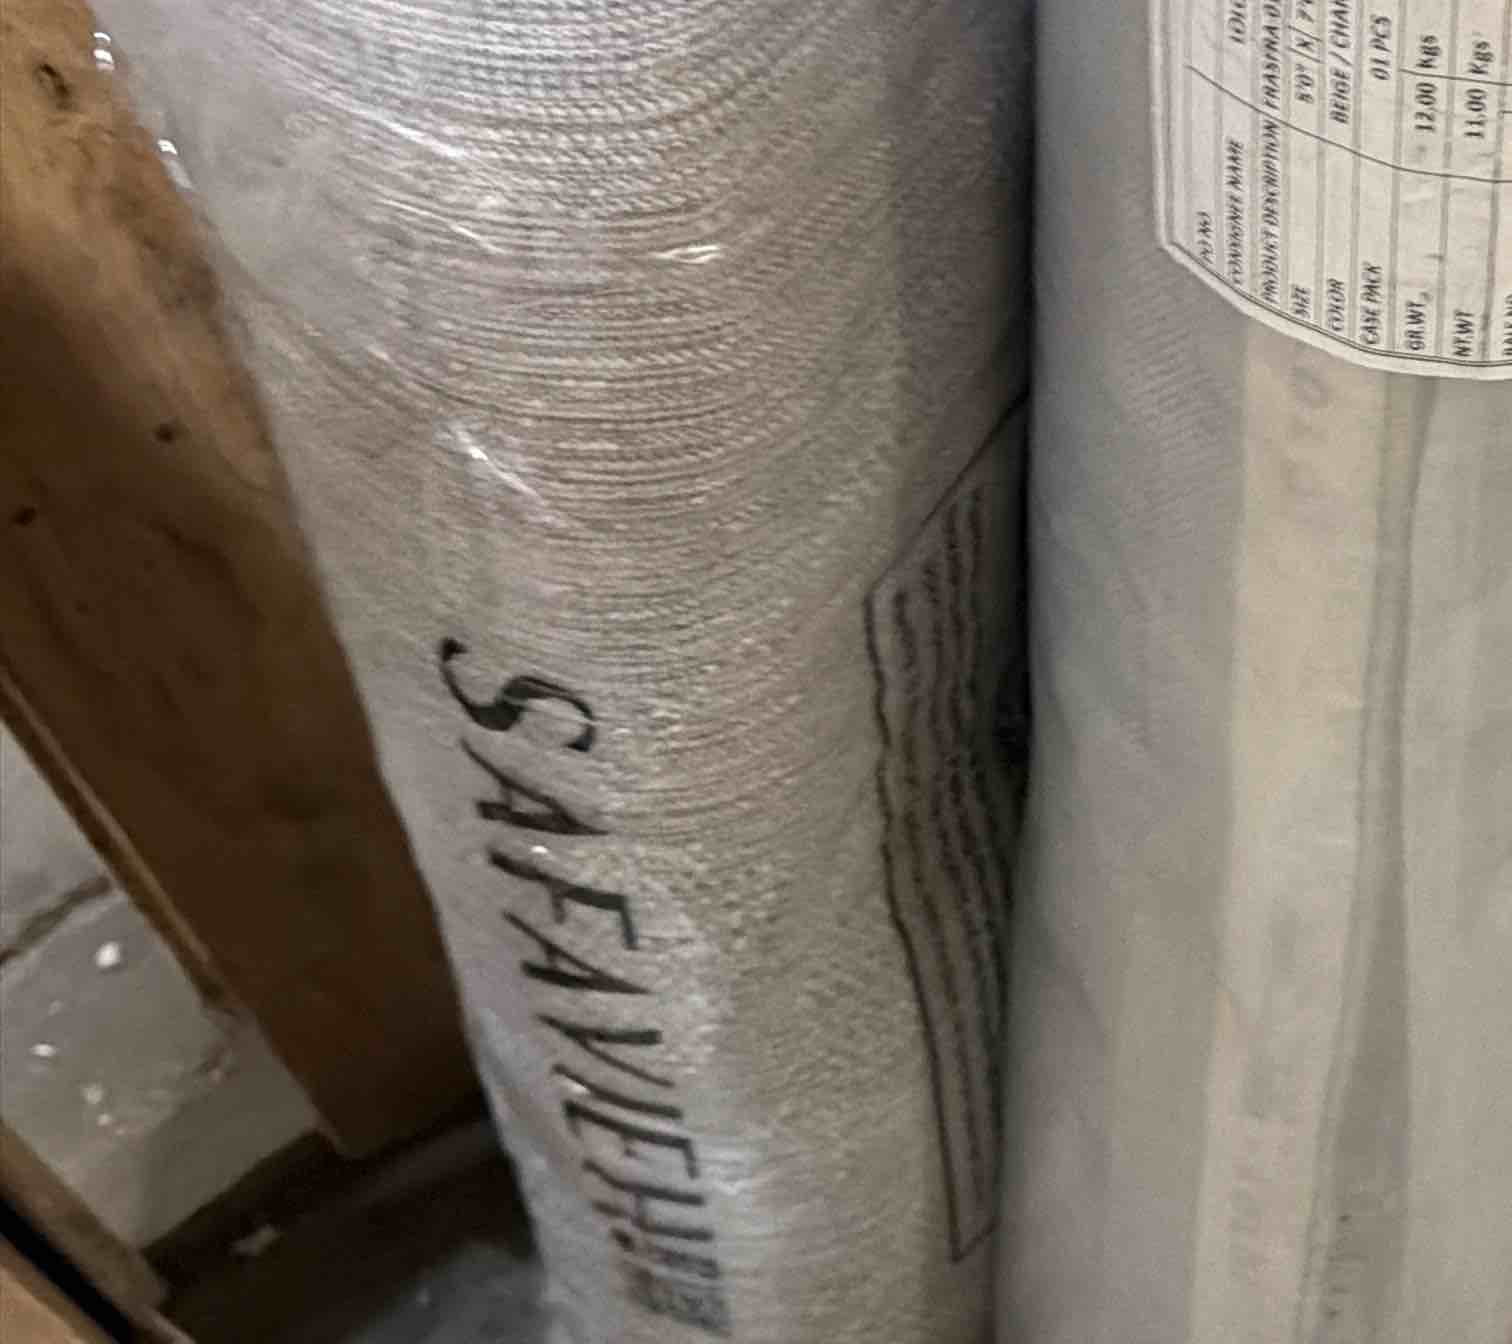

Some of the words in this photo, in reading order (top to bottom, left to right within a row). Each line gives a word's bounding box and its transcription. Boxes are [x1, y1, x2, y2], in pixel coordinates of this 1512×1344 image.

[1369, 13, 1392, 53] PCS
[1414, 34, 1442, 70] Kgs
[1368, 57, 1392, 81] 01
[1465, 40, 1495, 76] Kgs
[1328, 66, 1350, 126] BEIGE
[1224, 135, 1244, 192] NAME
[1261, 119, 1280, 227] DESCRIPTION
[1261, 230, 1280, 305] PRODUCT
[1361, 261, 1382, 304] PACK
[1289, 284, 1310, 318] SIZE
[1326, 277, 1345, 333] COLOR
[1359, 308, 1381, 346] CASE
[437, 634, 720, 1248] SAFAVIEH
